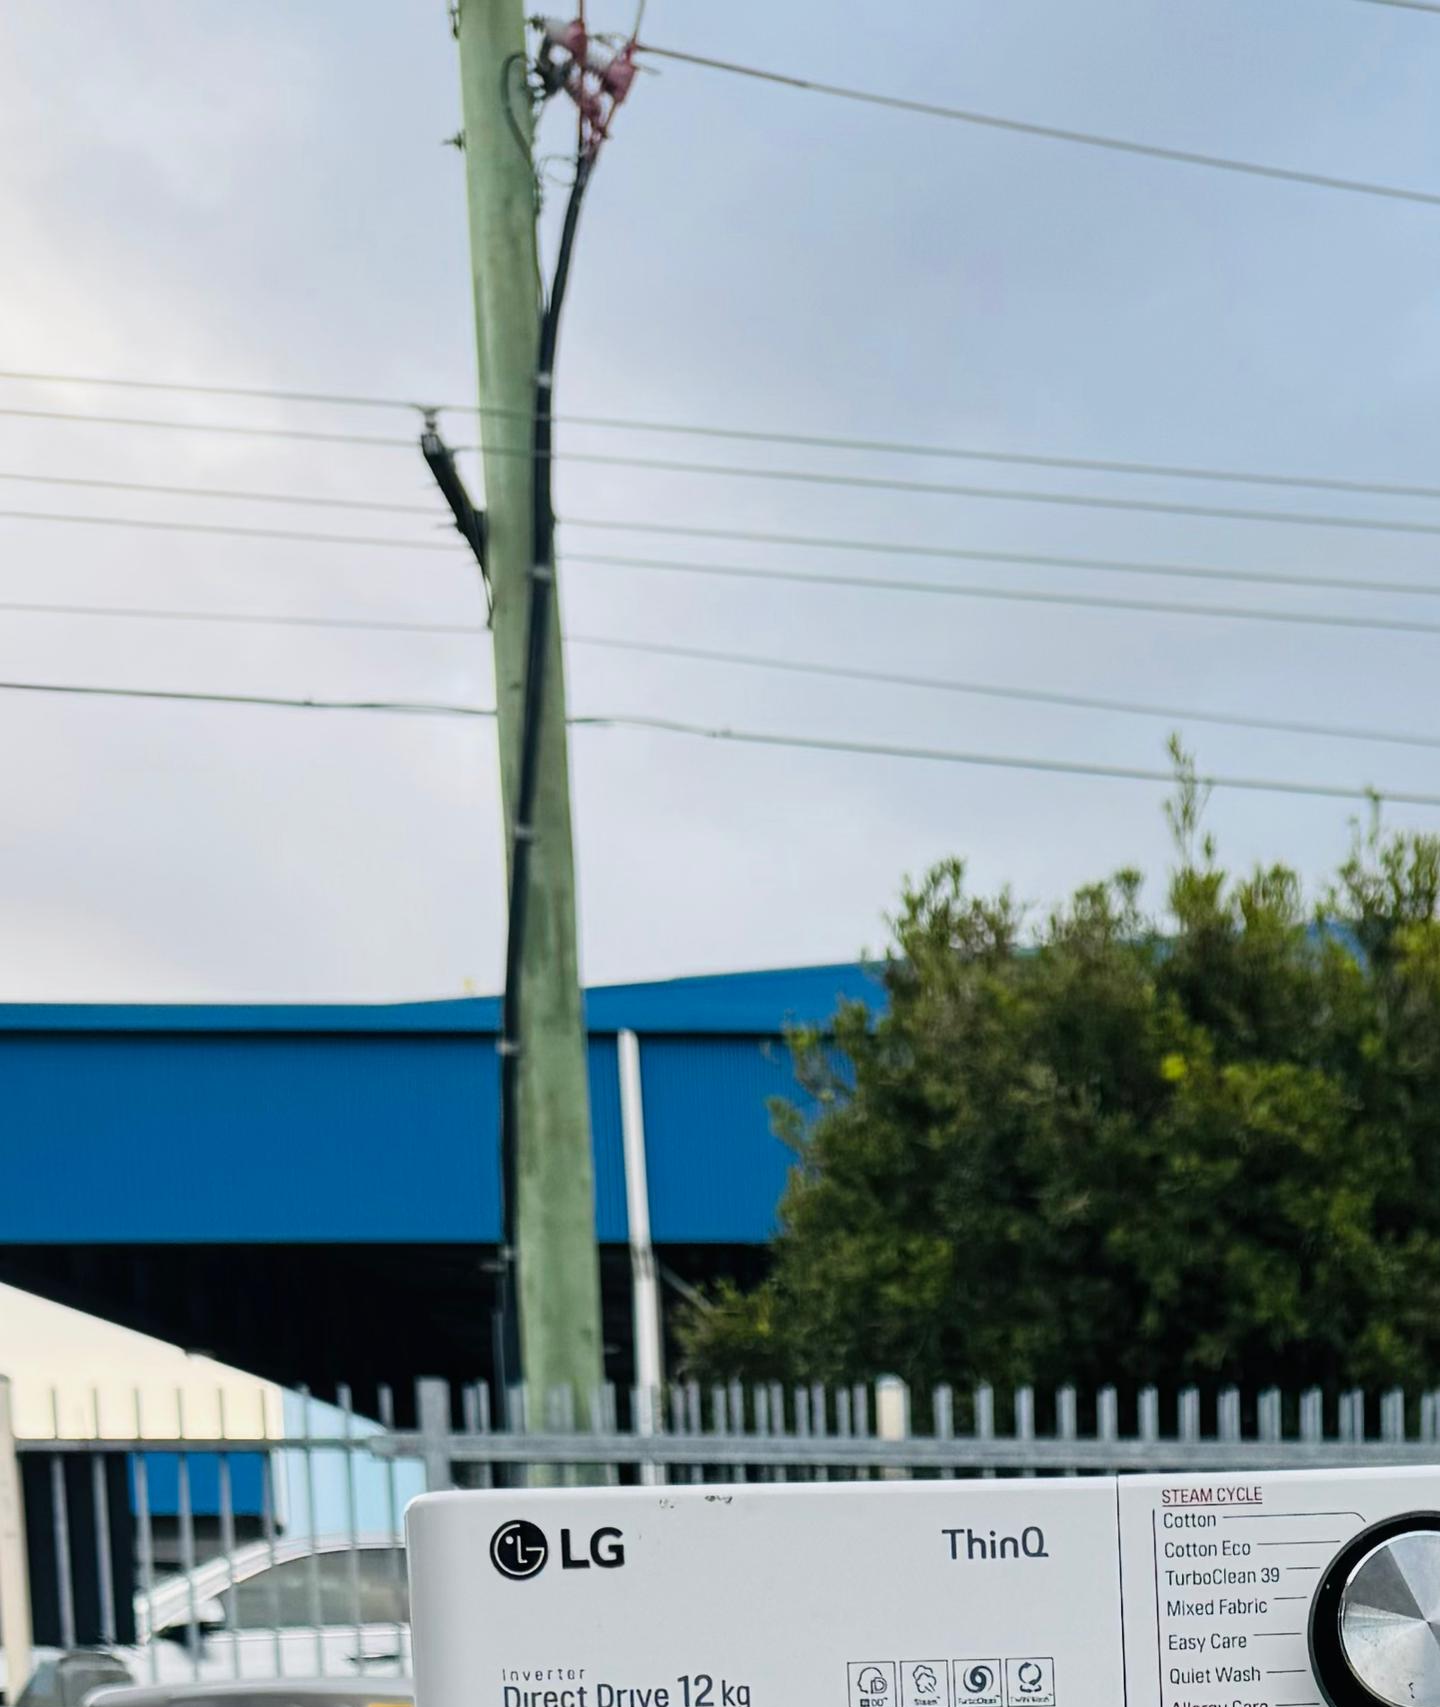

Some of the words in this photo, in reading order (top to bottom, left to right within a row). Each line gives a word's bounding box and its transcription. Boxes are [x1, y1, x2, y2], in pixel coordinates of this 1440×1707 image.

[1162, 1488, 1212, 1503] STEAM
[1217, 1486, 1262, 1502] CYCLE
[1163, 1513, 1216, 1528] Cotton
[561, 1527, 625, 1570] LG
[942, 1526, 1048, 1560] ThinQ
[1164, 1542, 1218, 1557] Cotton
[1222, 1540, 1251, 1556] Eco
[1165, 1568, 1257, 1585] TurboClean
[1261, 1567, 1280, 1583] 39
[1167, 1599, 1214, 1616] Mixed
[1217, 1598, 1268, 1615] Fabric
[1168, 1634, 1205, 1653] Easy
[1210, 1633, 1248, 1649] Care
[501, 1667, 587, 1682] Inverter
[1169, 1667, 1211, 1685] Quiet
[1214, 1666, 1261, 1683] Wash
[676, 1674, 714, 1707] 12
